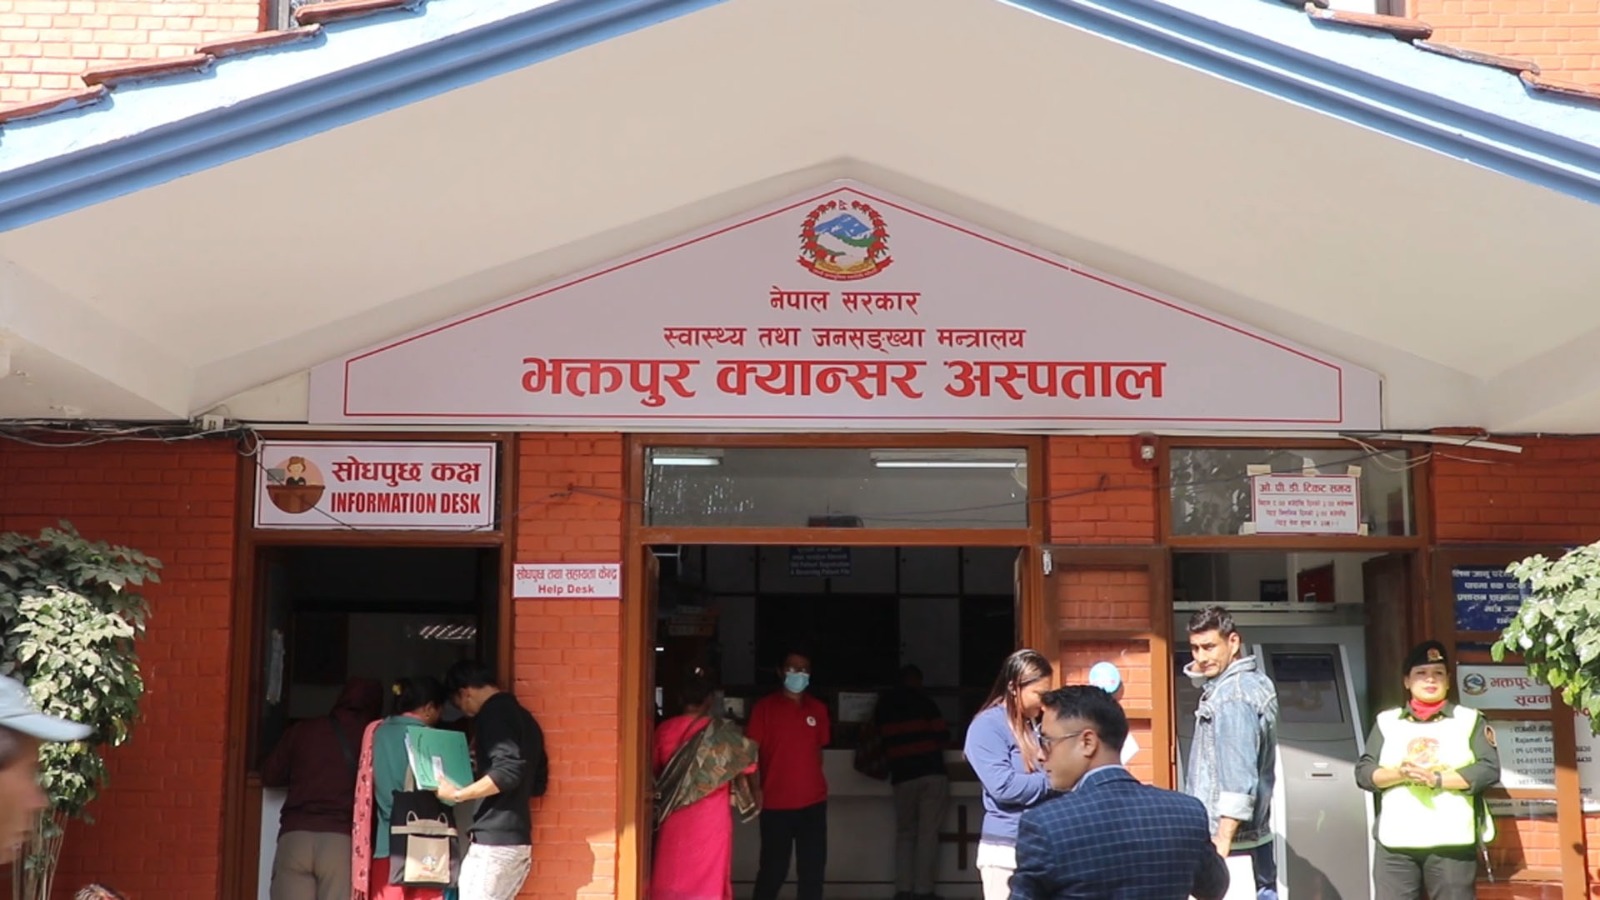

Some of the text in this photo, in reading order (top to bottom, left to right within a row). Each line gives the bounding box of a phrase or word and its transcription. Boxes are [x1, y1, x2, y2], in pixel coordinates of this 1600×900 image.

[770, 285, 921, 315] नेपाल सरकार
[663, 327, 1026, 354] स्वास्थ्य तथा जनसङ्ख्या मन्त्रालय
[521, 357, 1167, 407] भक्तपुर क्यान्सर अस्पताल
[331, 456, 482, 487] सोधपुछ कक्ष
[1303, 482, 1327, 493] टिकट
[1329, 484, 1352, 493] समय
[331, 492, 481, 514] INFORMATION DESK
[547, 569, 563, 580] तथा
[565, 569, 596, 580] सहायता
[538, 584, 595, 595] Help Desk
